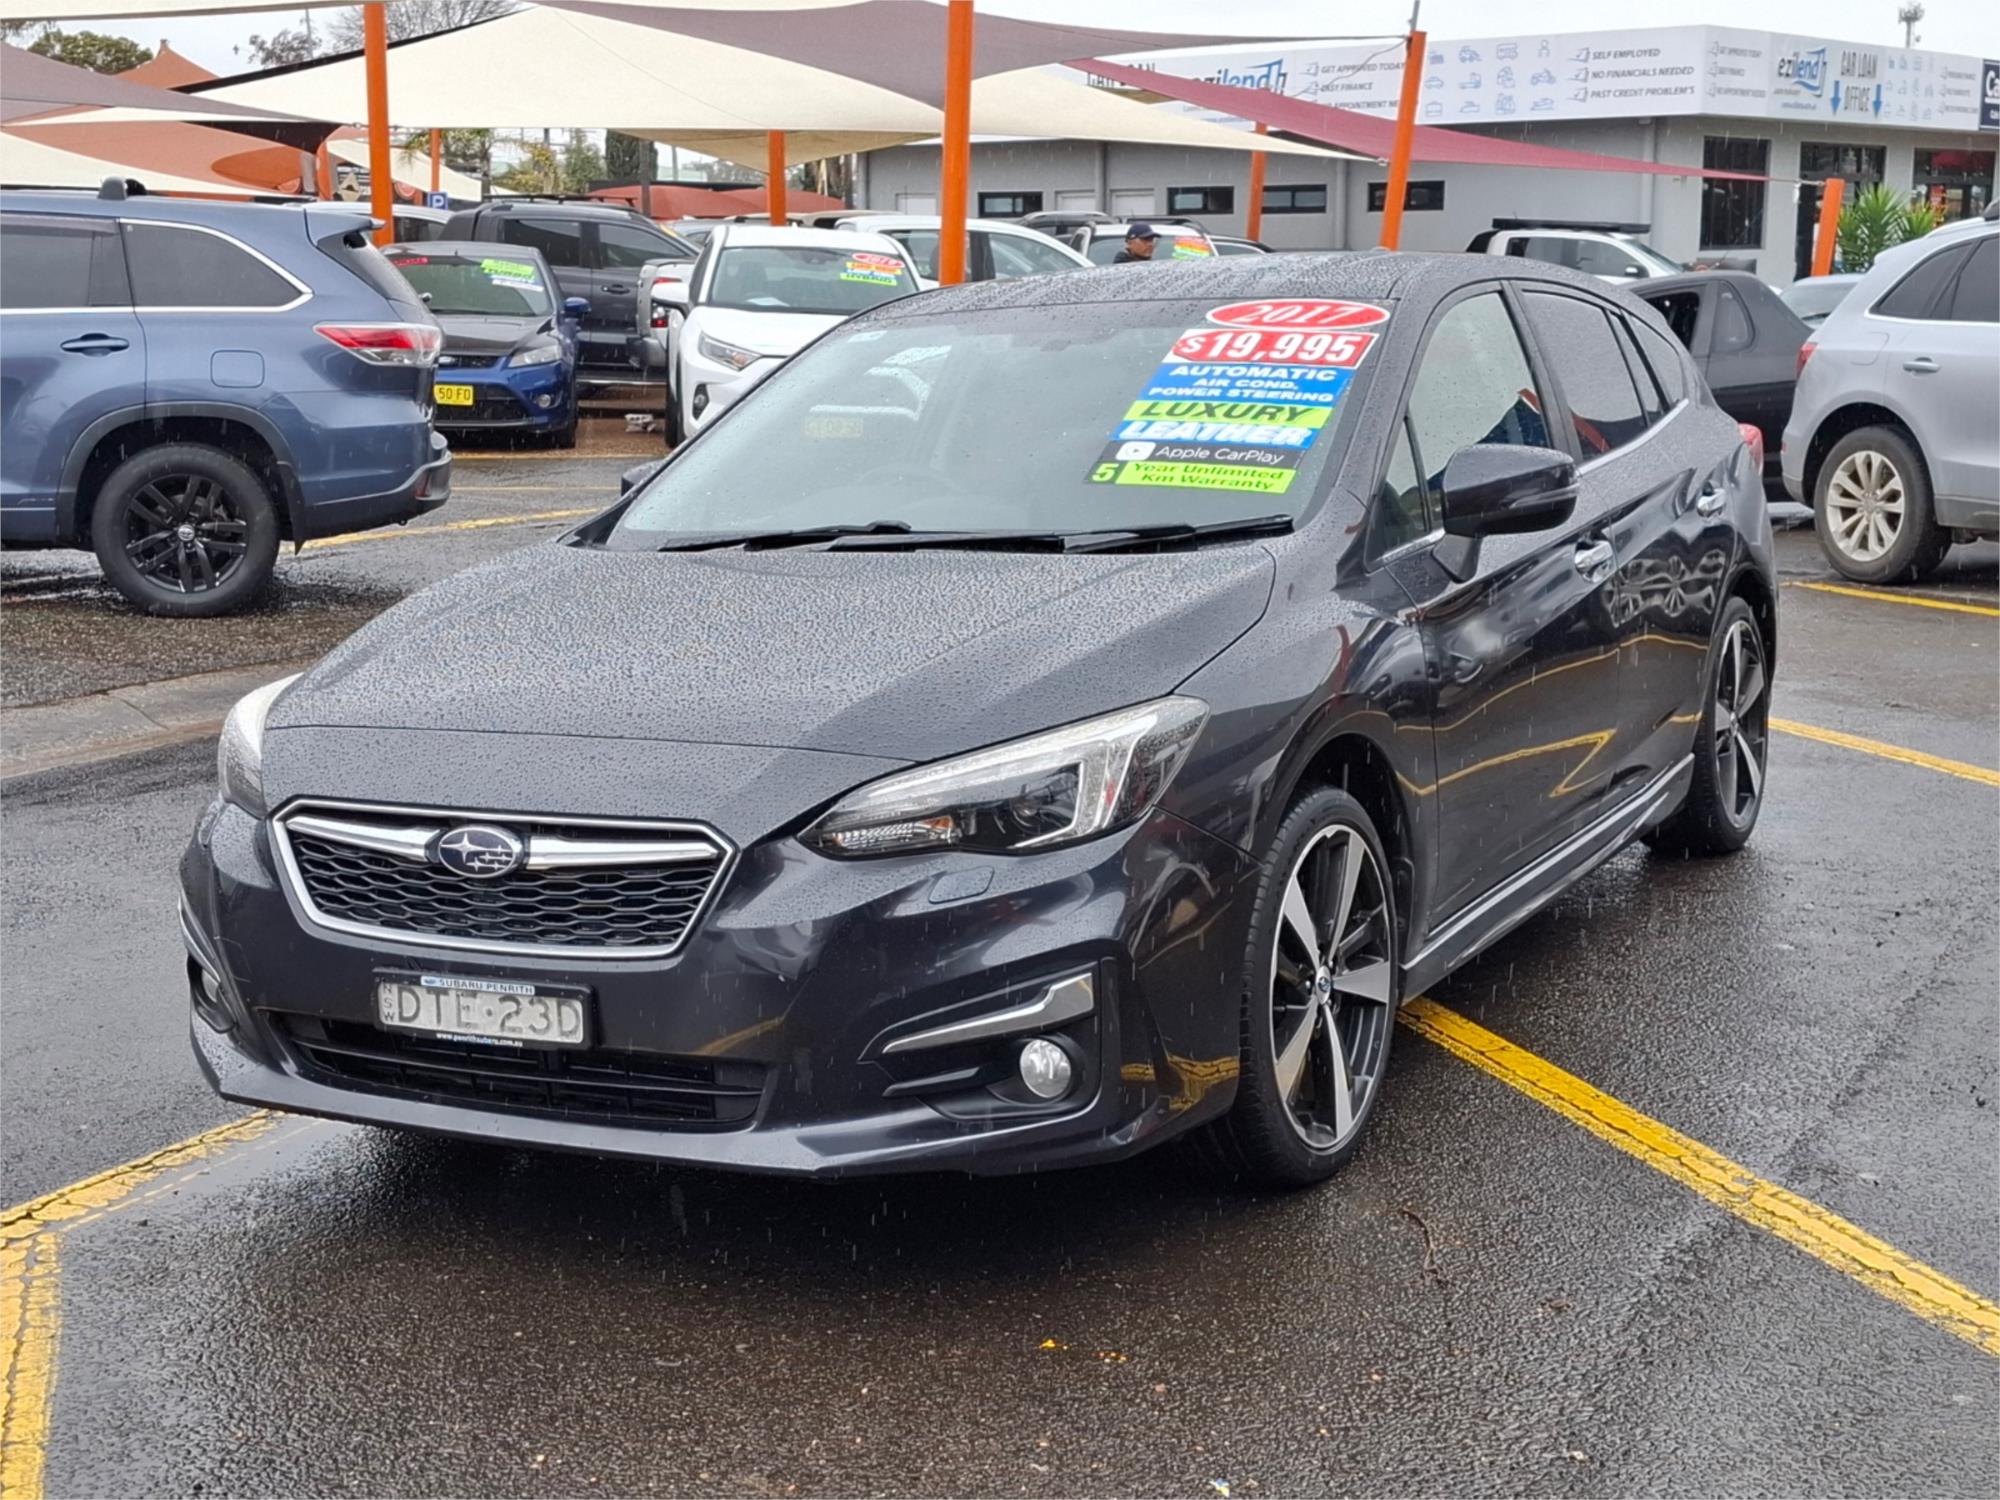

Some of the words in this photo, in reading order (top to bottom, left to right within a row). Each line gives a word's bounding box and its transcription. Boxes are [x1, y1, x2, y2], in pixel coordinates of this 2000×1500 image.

[1592, 51, 1612, 60] SELF
[1613, 48, 1661, 59] EMPLOYED
[1591, 70, 1606, 79] NO
[1607, 68, 1657, 78] FINANCIALS
[1658, 66, 1695, 76] NEEDED
[1590, 89, 1612, 99] PAST
[1613, 88, 1644, 98] CREDIT
[1644, 86, 1696, 96] PROBLEM'S
[432, 195, 445, 210] P
[1233, 305, 1365, 324] 2017
[1181, 332, 1363, 363] $19,995
[1169, 366, 1338, 381] AUTOMATIC
[1193, 378, 1232, 387] AIR
[1235, 379, 1299, 390] COND.
[439, 387, 453, 400] 50
[1148, 387, 1222, 399] POWER
[1227, 388, 1334, 403] STEERING
[1140, 402, 1318, 422] LUXURY
[1118, 421, 1313, 446] LEATHER
[1155, 446, 1211, 460] Apple
[1214, 447, 1285, 465] CarPlay
[1092, 463, 1120, 482] 5
[1134, 463, 1178, 474] Year
[1183, 464, 1285, 480] Unlimited
[1141, 473, 1175, 484] Km
[1181, 474, 1276, 491] Warranty
[439, 979, 483, 992] SUBARU
[486, 982, 533, 994] PENRITH
